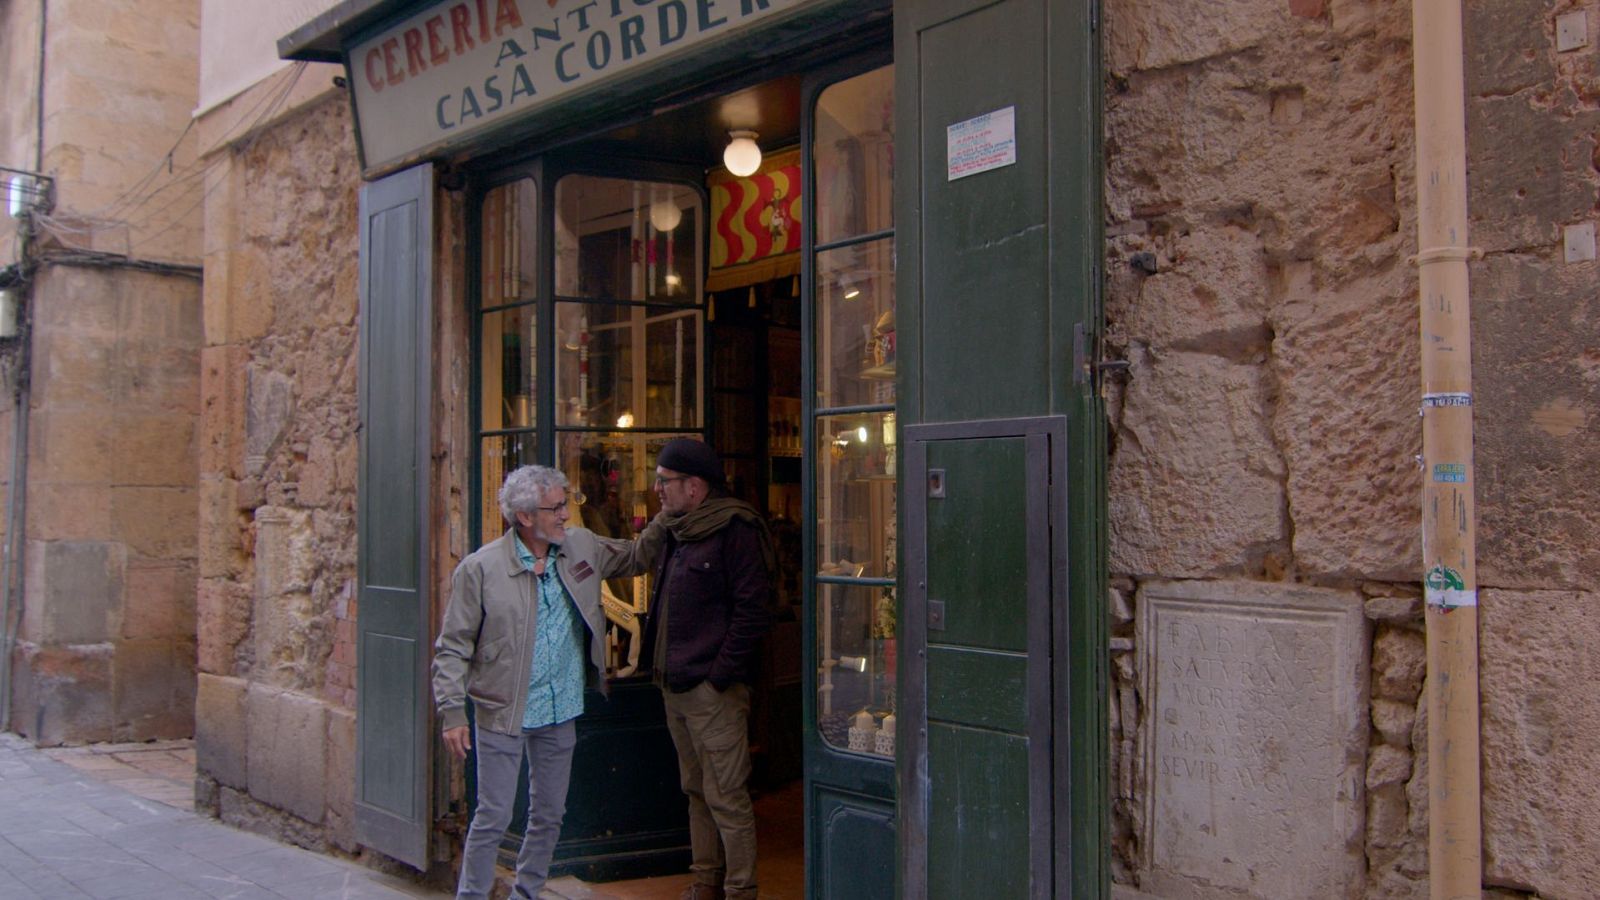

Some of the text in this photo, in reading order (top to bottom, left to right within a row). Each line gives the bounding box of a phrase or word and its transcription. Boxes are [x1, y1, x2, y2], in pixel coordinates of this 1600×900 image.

[365, 0, 523, 93] CERERIA
[494, 0, 657, 68] ANTI
[436, 63, 537, 130] CASA
